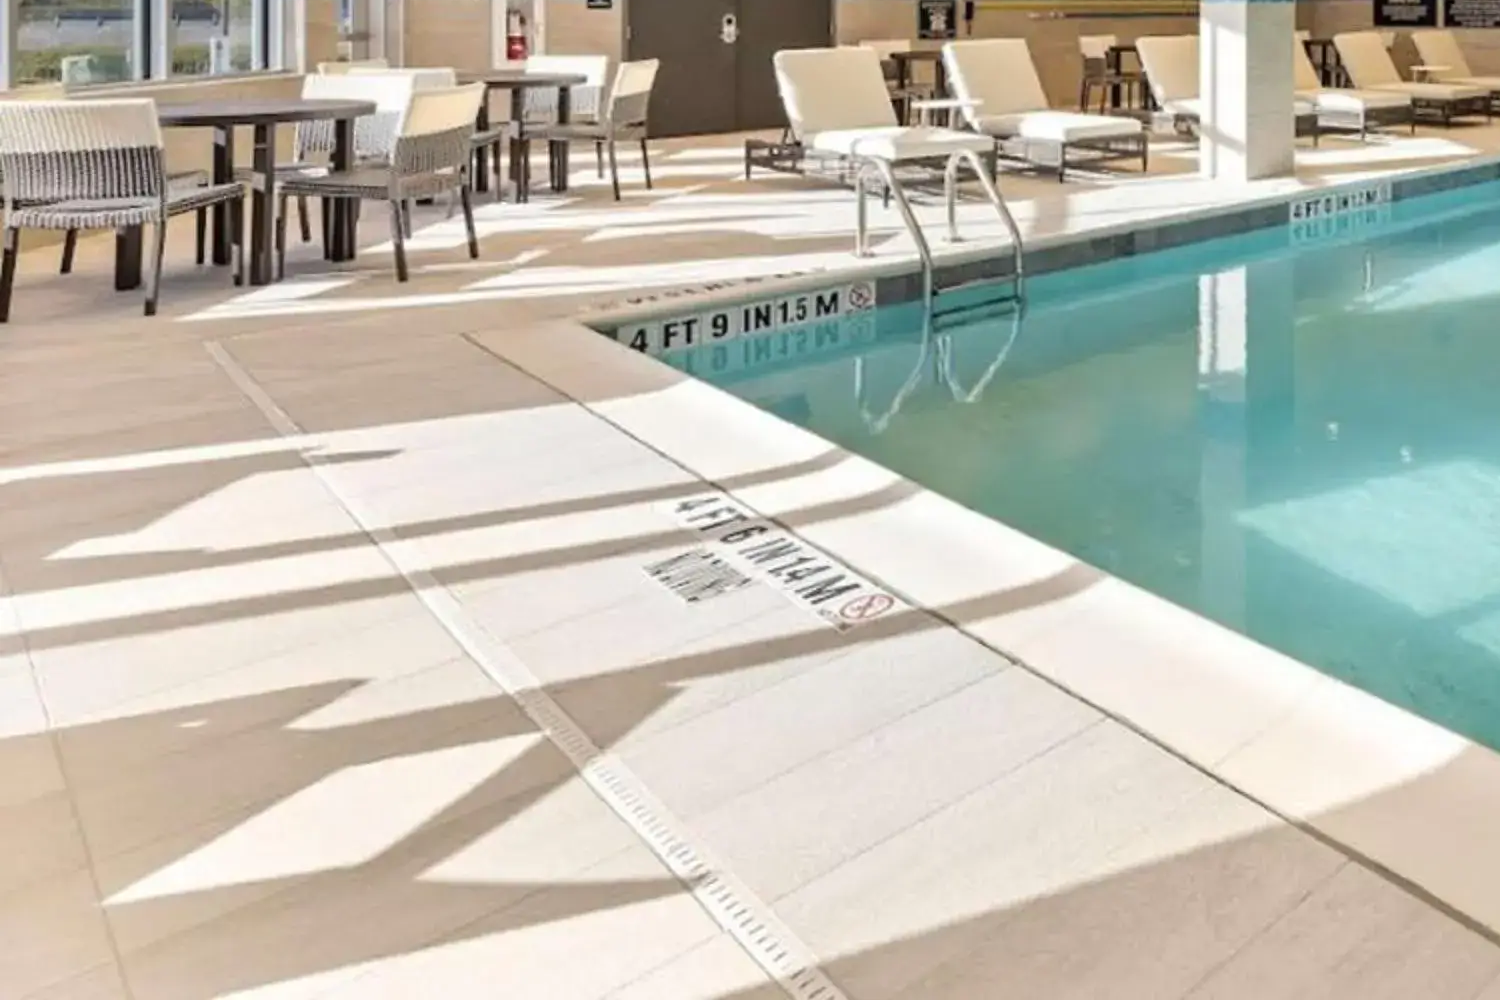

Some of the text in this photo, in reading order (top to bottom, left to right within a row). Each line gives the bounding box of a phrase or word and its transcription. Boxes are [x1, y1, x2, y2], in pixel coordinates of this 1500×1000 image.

[1305, 200, 1321, 218] FT
[629, 328, 649, 353] 4
[663, 318, 698, 349] FT
[711, 313, 730, 338] 9
[743, 303, 772, 333] IN
[778, 297, 808, 325] 1.5
[814, 291, 840, 317] M
[675, 497, 721, 514] 4
[686, 506, 750, 532] FT
[719, 525, 769, 544] 6
[738, 537, 802, 565] IN
[794, 574, 862, 606] M
